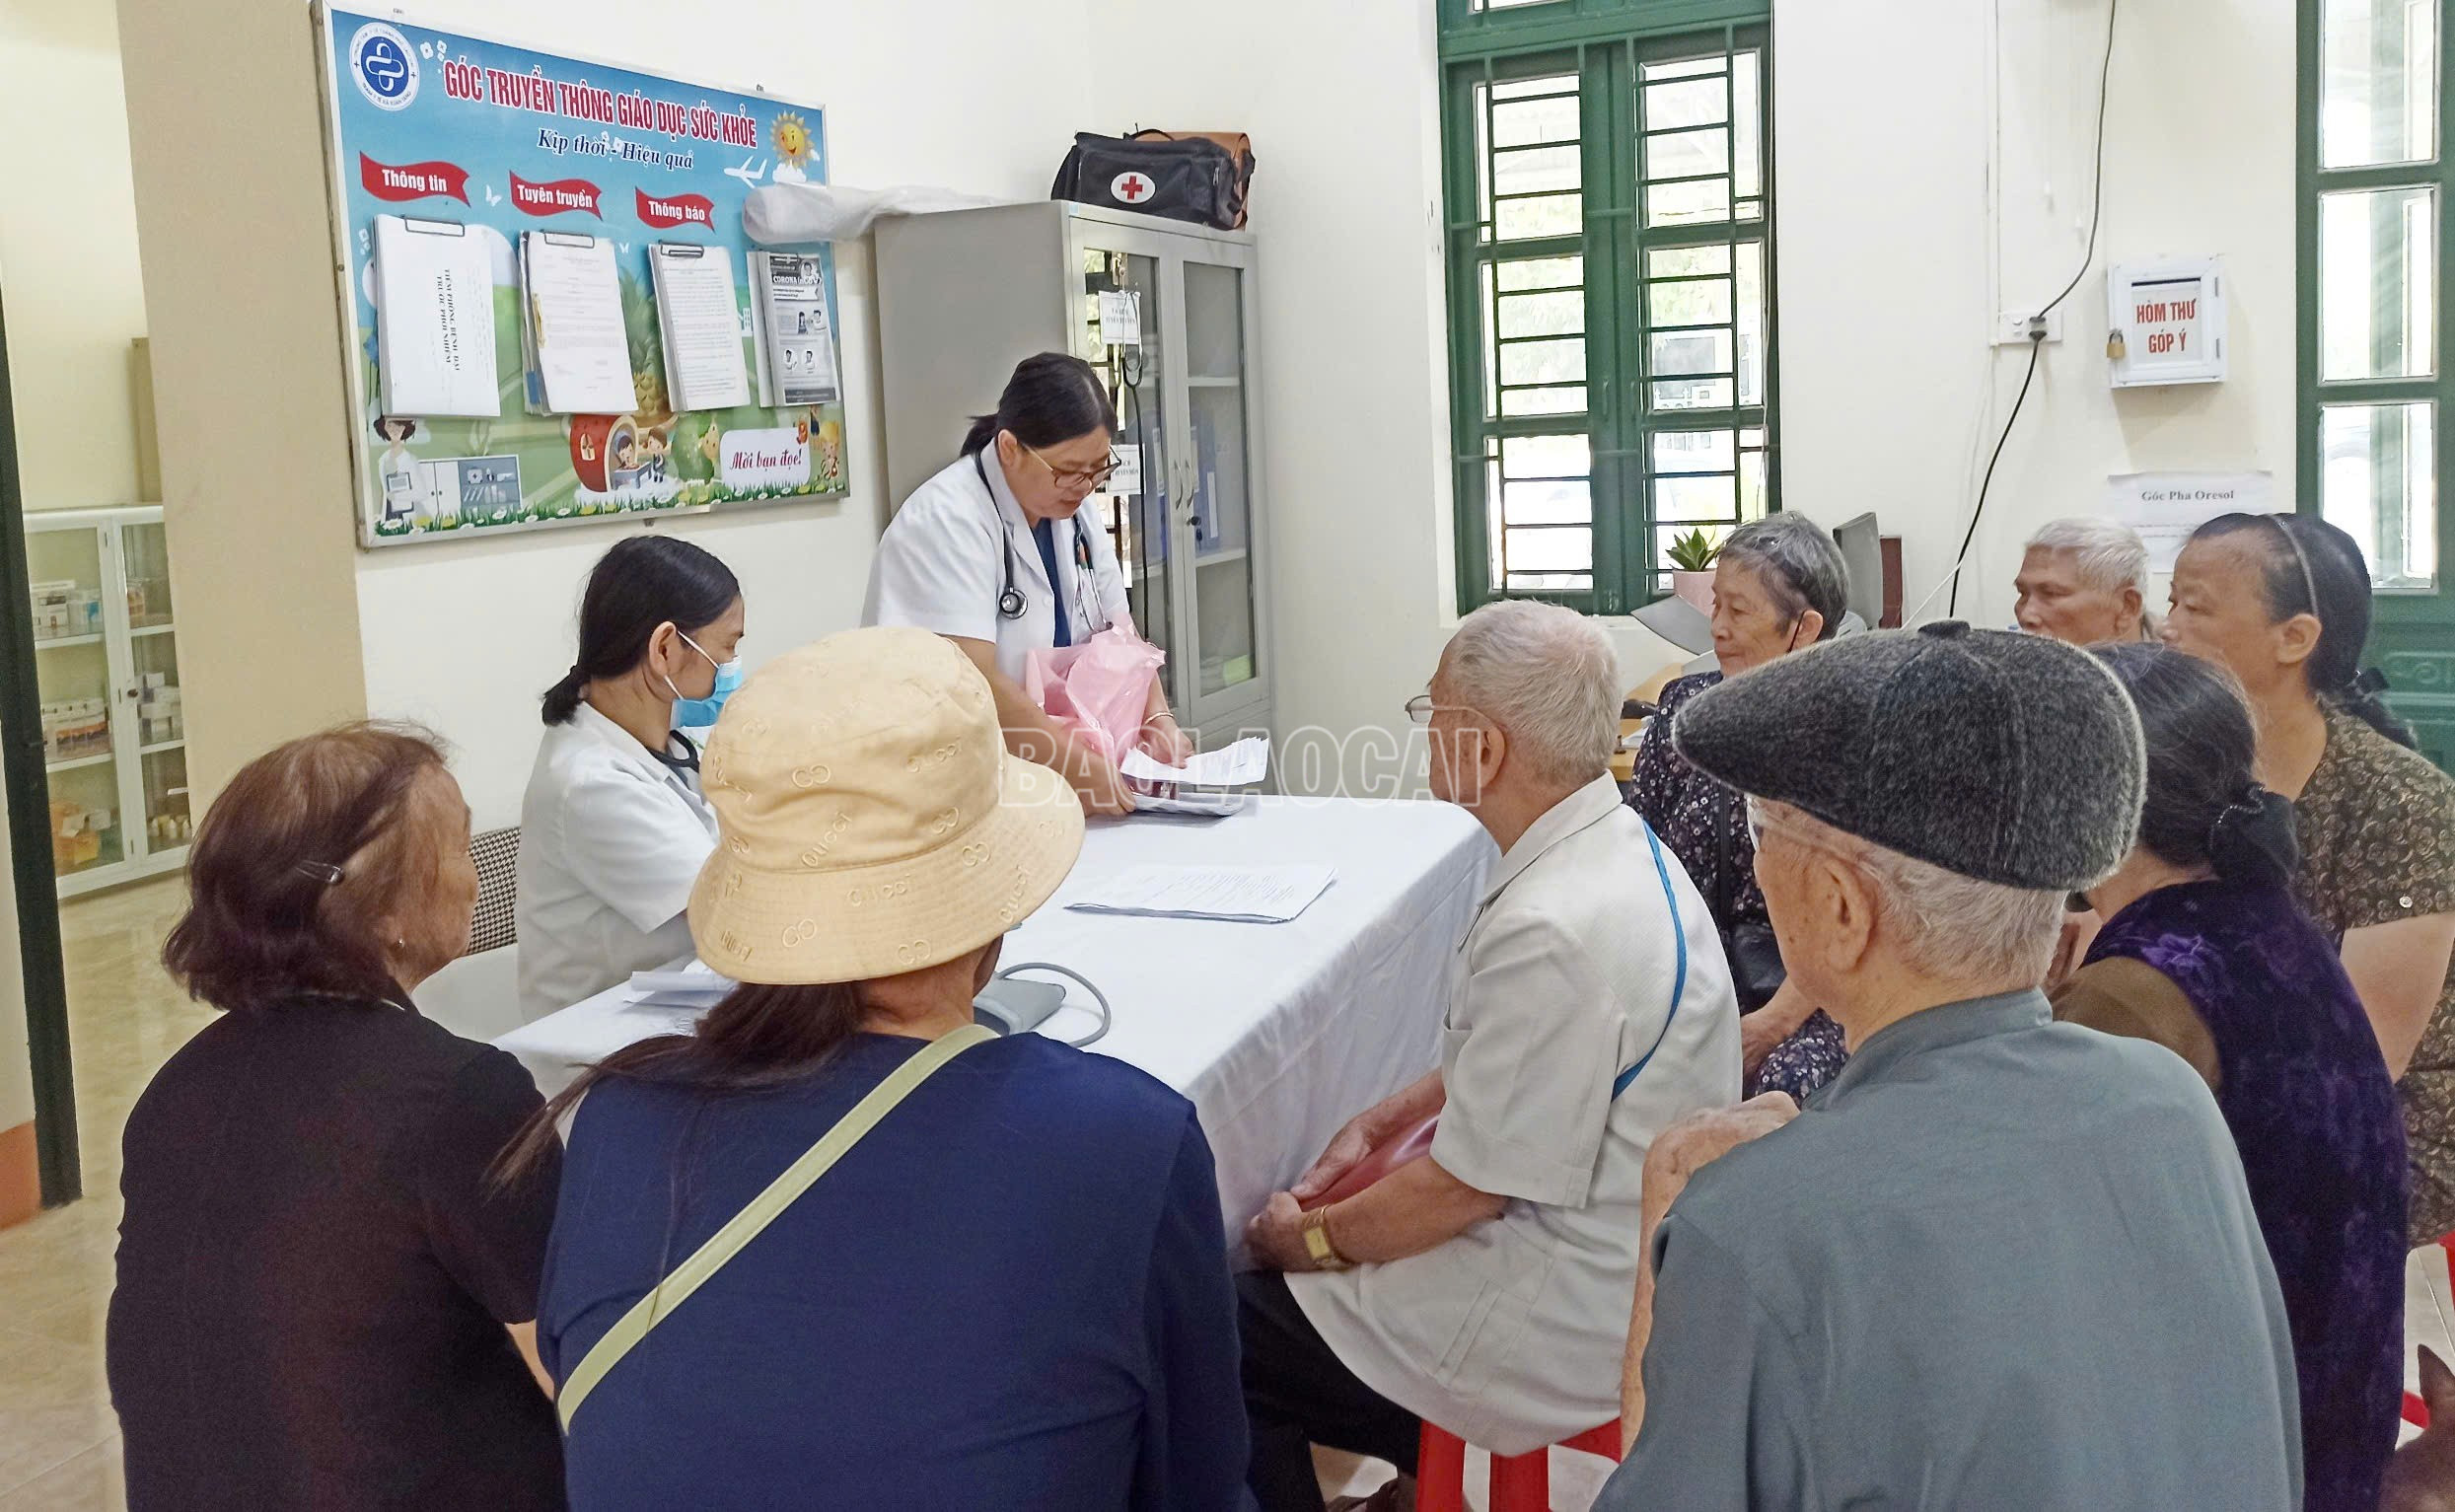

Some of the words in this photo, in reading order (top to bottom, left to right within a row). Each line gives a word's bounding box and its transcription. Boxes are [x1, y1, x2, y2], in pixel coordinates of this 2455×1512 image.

[444, 55, 483, 103] GÓC
[486, 64, 556, 114] TRUYỀN
[558, 79, 614, 124] THÔNG
[617, 89, 653, 131] GIÁO
[656, 100, 687, 142] DỤC
[690, 100, 719, 142] SỨC
[721, 104, 758, 149] KHỎE
[539, 128, 568, 156] Kịp
[573, 134, 607, 157] thời
[621, 141, 660, 167] Hiệu
[665, 150, 694, 172] quả
[382, 169, 426, 191] Thông
[428, 175, 448, 192] tin
[517, 184, 555, 204] Tuyên
[556, 189, 593, 208] truyền
[648, 200, 683, 220] Thông
[685, 205, 705, 221] báo
[2136, 300, 2166, 324] HÒM
[2170, 298, 2197, 322] THƯ
[2148, 328, 2174, 354] GÓP
[2179, 327, 2187, 352] Ý
[730, 451, 754, 470] Mời
[757, 450, 776, 471] bạn
[2141, 490, 2166, 501] Góc
[2169, 490, 2192, 501] Pha
[2195, 490, 2234, 501] Oresol
